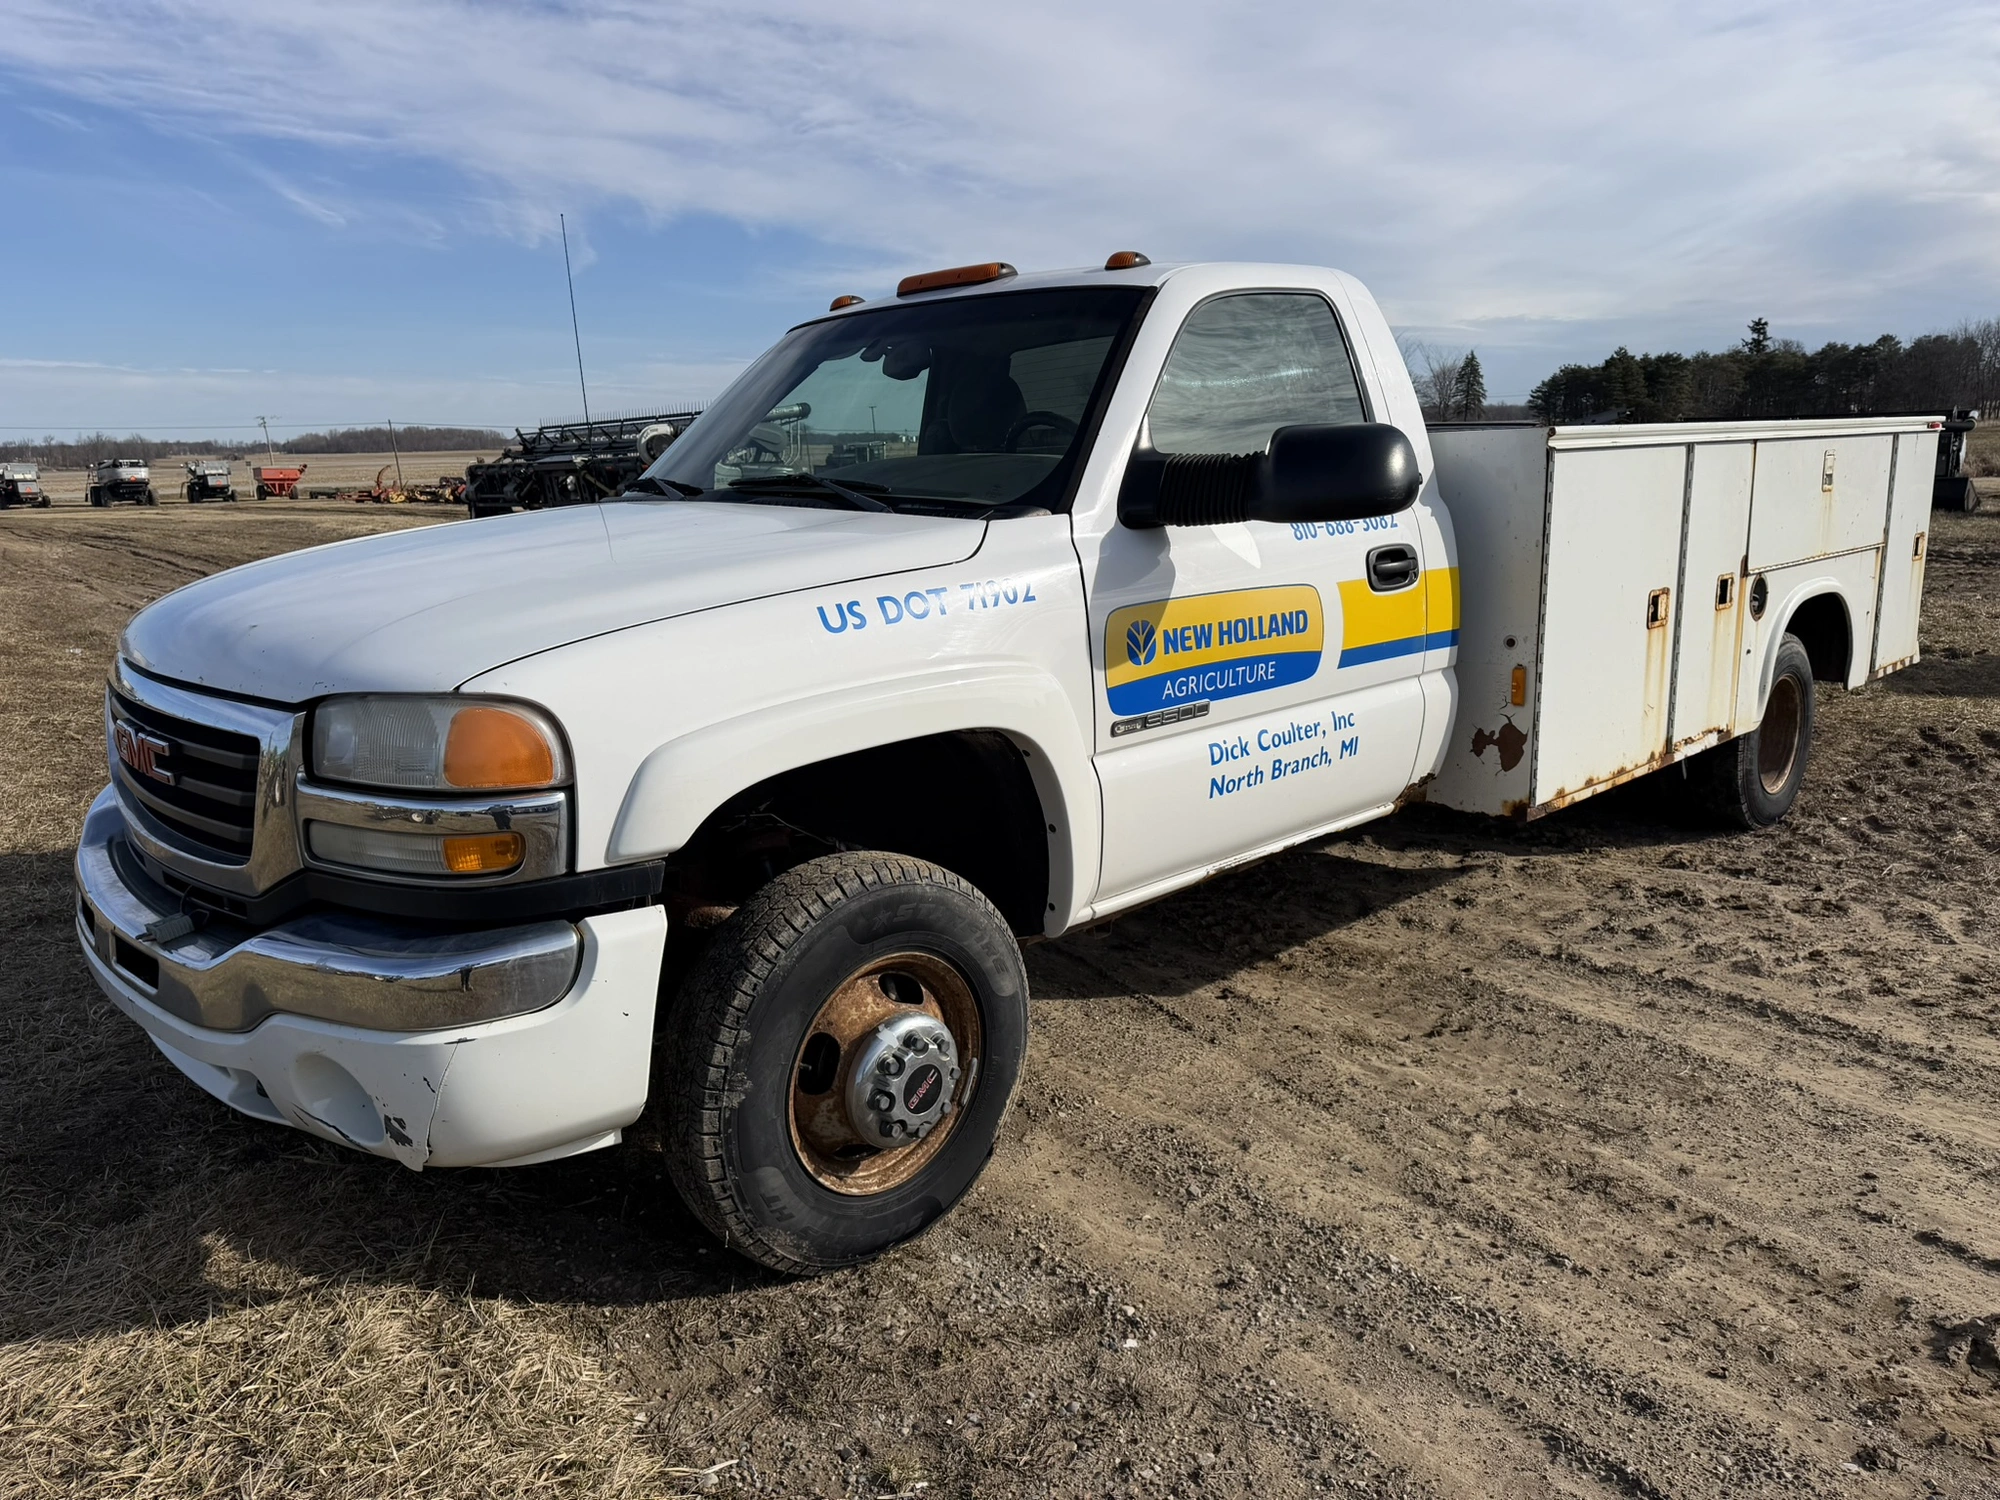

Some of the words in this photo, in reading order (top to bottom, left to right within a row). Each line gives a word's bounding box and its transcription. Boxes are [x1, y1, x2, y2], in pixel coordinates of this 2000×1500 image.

[1290, 515, 1398, 541] 810-688-3082
[817, 600, 867, 633] US
[876, 587, 947, 625] DOT
[960, 577, 1036, 610] 71902
[1163, 621, 1215, 655] NEW
[1218, 609, 1308, 646] HOLLAND
[1162, 661, 1276, 700] AGRICULTURE
[114, 719, 176, 786] GMC
[1208, 737, 1250, 766] Dick
[1257, 720, 1327, 752] Coulter,
[1331, 711, 1355, 732] Inc
[1209, 765, 1264, 799] North
[1270, 746, 1332, 781] Branch,
[1339, 736, 1359, 759] MI
[908, 1068, 938, 1109] GMC
